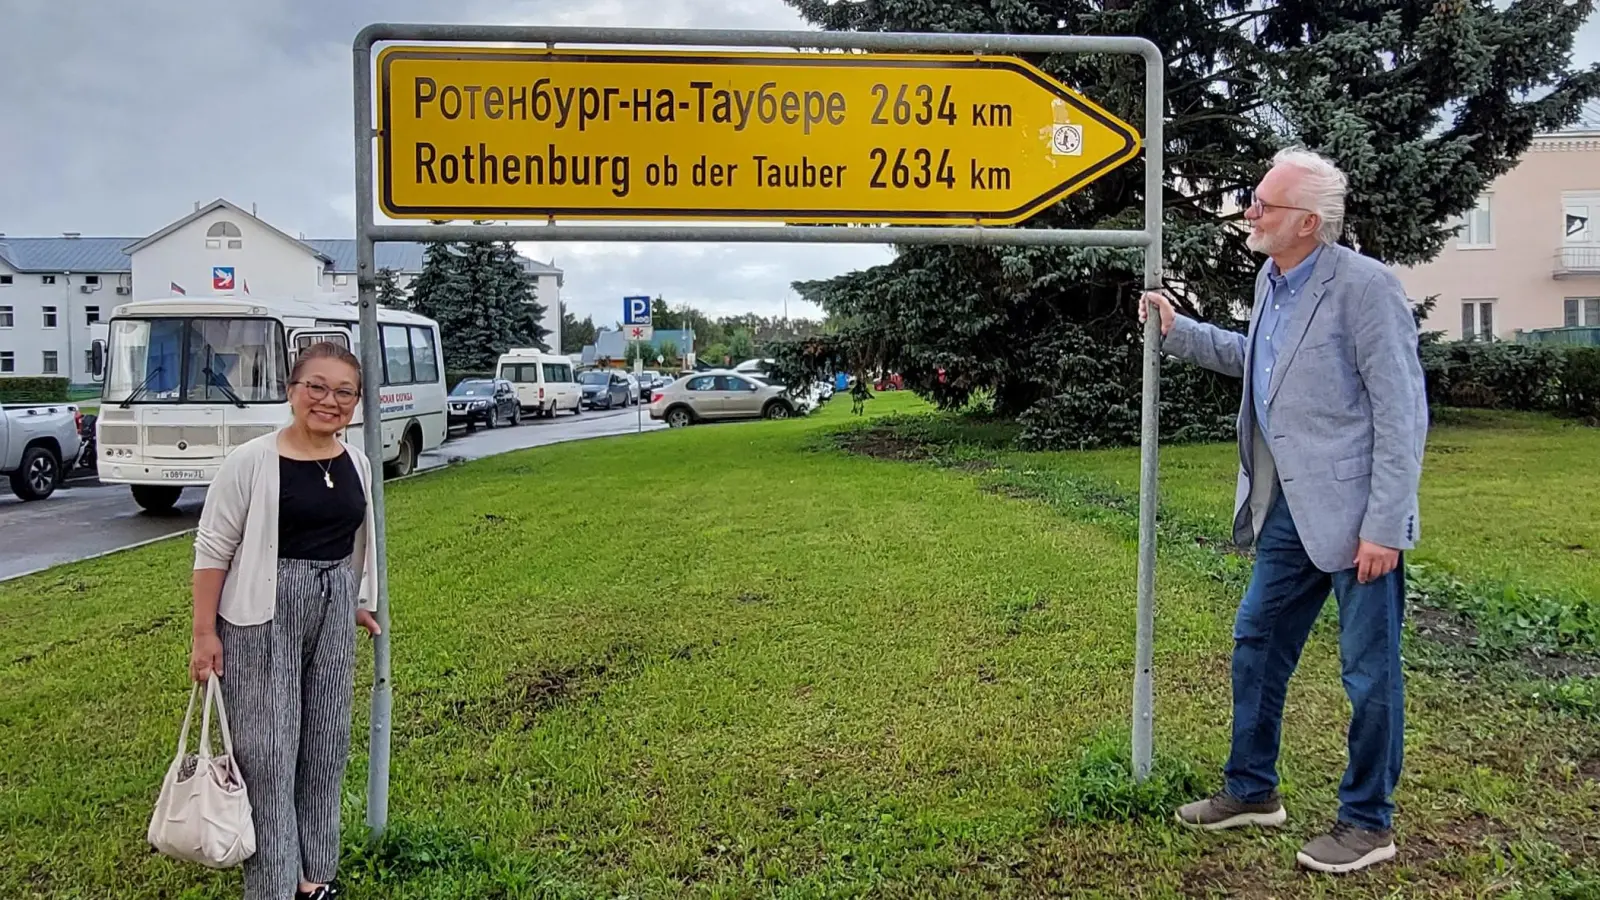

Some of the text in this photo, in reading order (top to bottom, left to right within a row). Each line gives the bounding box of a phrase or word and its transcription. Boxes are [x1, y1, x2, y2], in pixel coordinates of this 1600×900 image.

[414, 76, 846, 135] Ротенбург-на-Таубере
[870, 84, 957, 126] 2634
[414, 142, 1011, 198] Rothenburg ob der Tauber 2634 km
[631, 299, 646, 323] P
